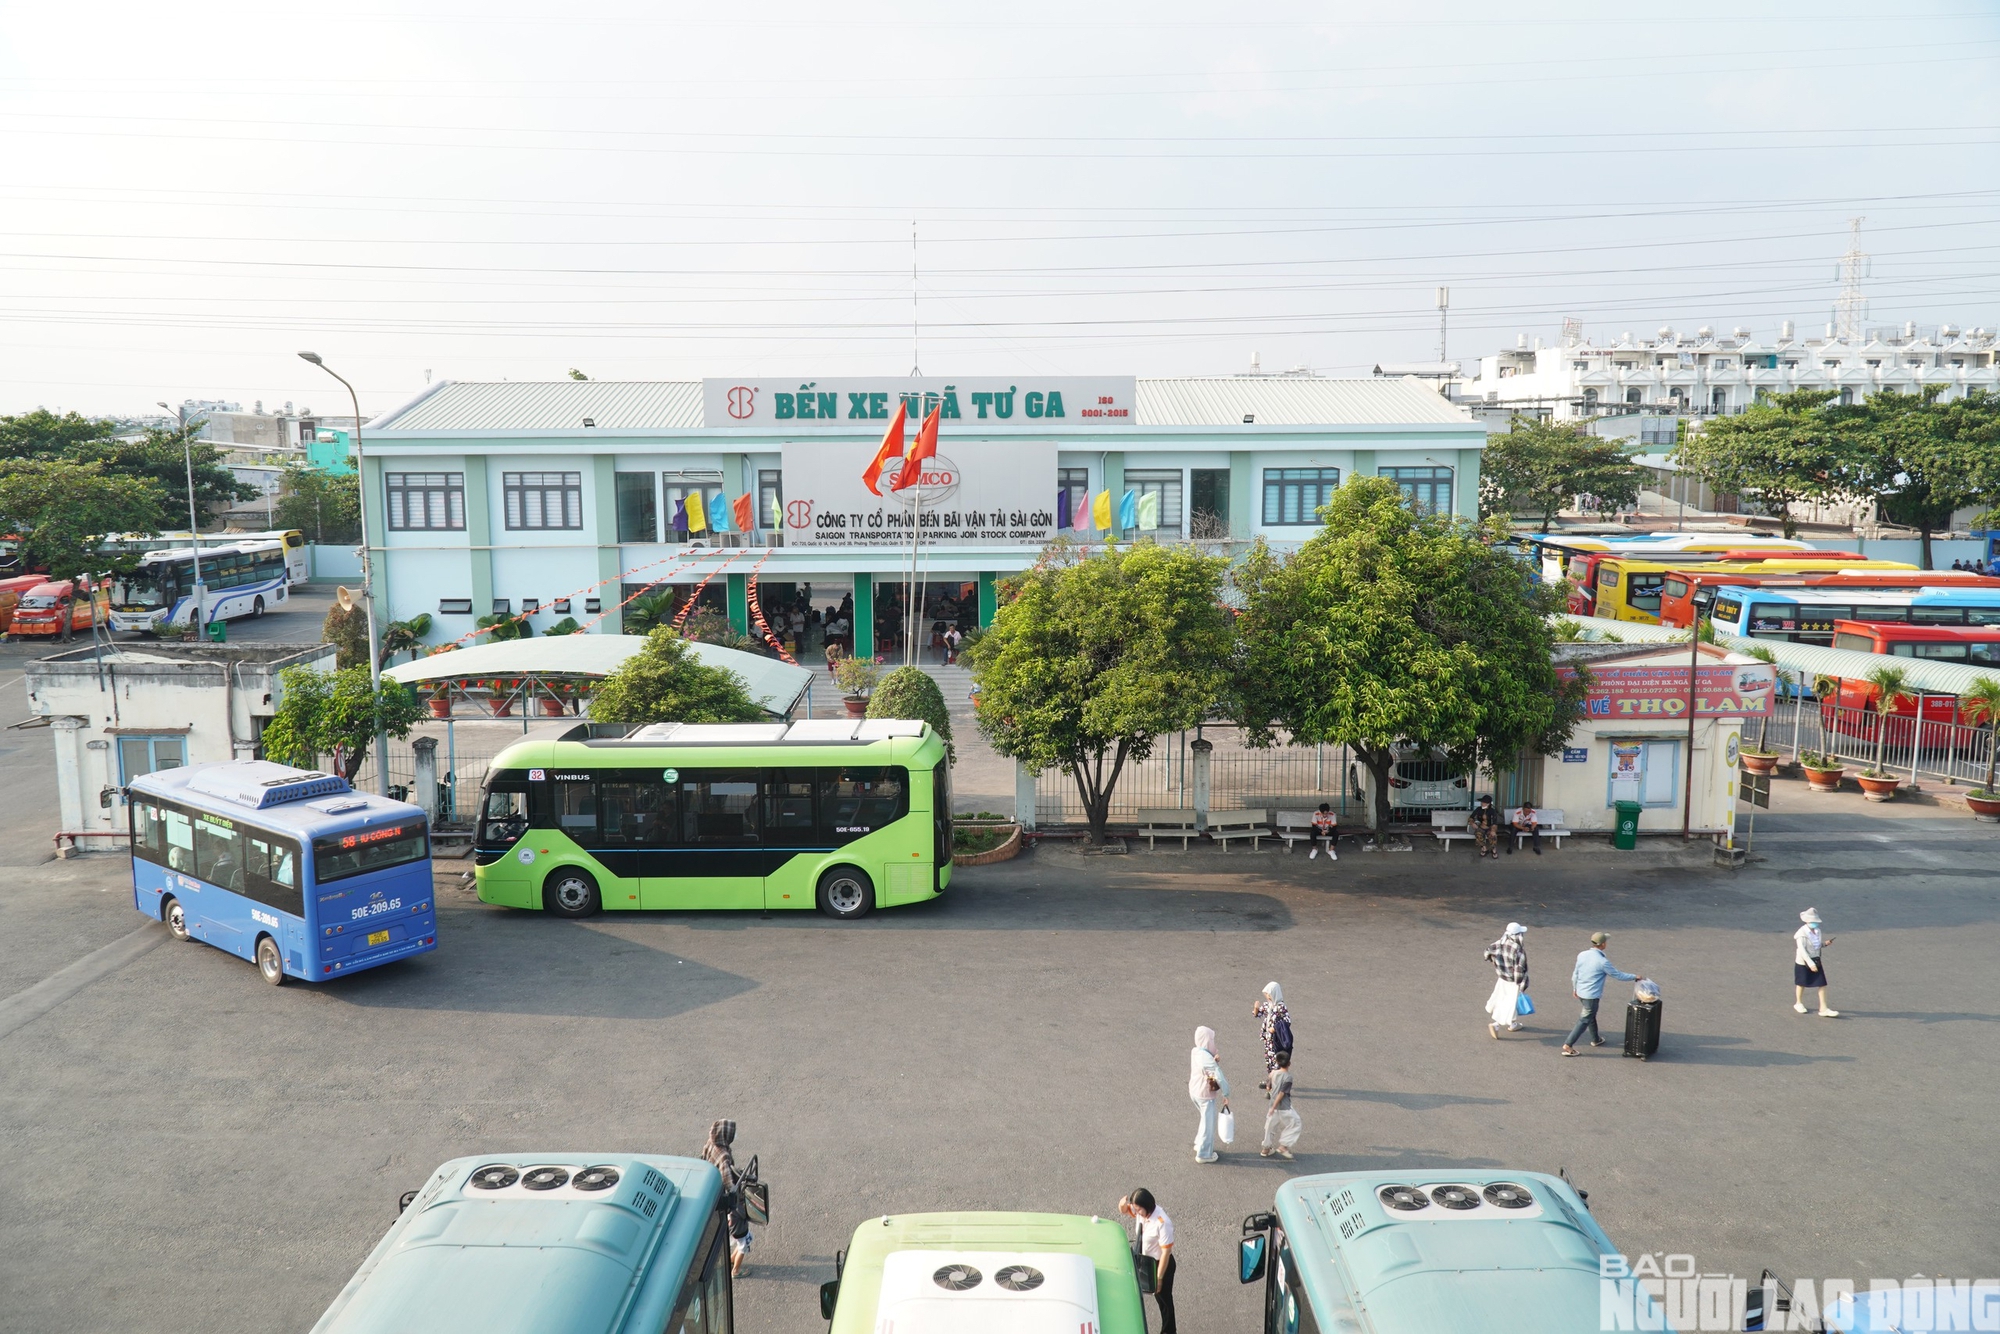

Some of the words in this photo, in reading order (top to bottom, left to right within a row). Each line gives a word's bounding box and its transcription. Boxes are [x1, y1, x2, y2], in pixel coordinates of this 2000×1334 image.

[775, 382, 837, 419] BẾN
[848, 392, 888, 419] XE
[899, 385, 961, 419] NGÃ
[971, 385, 1017, 418] TƯ
[1025, 392, 1065, 418] GA
[1098, 396, 1113, 404] ISO
[1082, 409, 1128, 417] 9001-2015
[889, 472, 952, 485] SMCO
[816, 511, 846, 528] CÔNG
[850, 514, 864, 527] TY
[868, 508, 882, 528] CỔ
[887, 509, 915, 528] PHẦN
[944, 511, 960, 527] BÃI
[965, 510, 986, 529] VẬN
[990, 508, 1006, 527] TẢI
[1010, 510, 1026, 527] SÀI
[1030, 509, 1052, 526] GÒN
[1010, 530, 1046, 538] COMPANY
[1623, 670, 1649, 678] PHẦN
[1590, 695, 1611, 714] VÉ
[1617, 698, 1686, 717] THỌ
[1695, 697, 1767, 714] LAM
[531, 770, 542, 780] 32
[342, 836, 356, 848] 58
[371, 828, 394, 841] CÔNG
[352, 898, 402, 920] 50E-209.65
[252, 908, 279, 928] 50E-209.65
